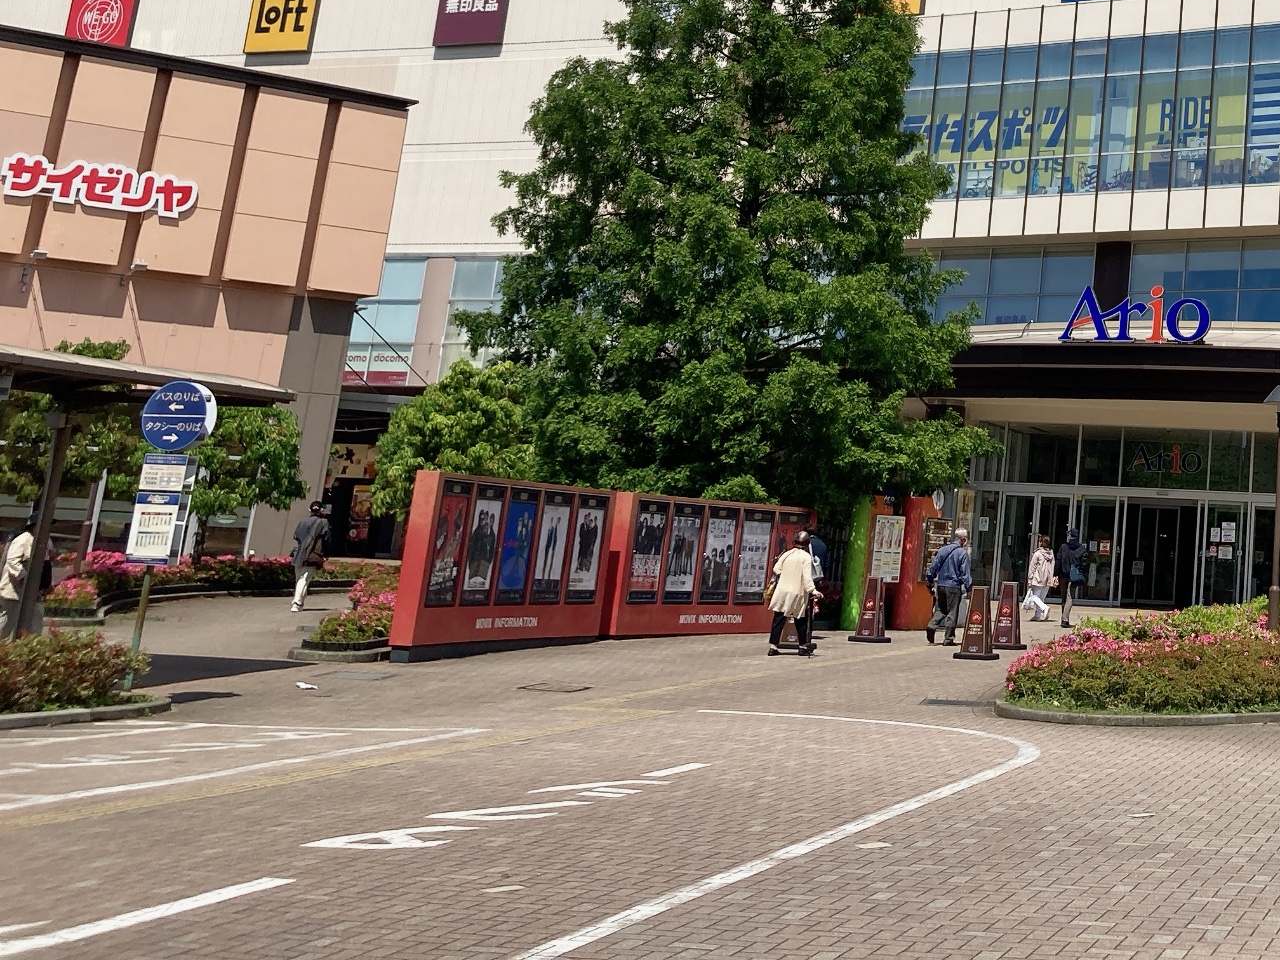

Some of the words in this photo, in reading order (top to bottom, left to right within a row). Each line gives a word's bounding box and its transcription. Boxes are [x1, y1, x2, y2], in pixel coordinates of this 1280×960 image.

[1160, 95, 1210, 132] RIDE
[902, 106, 1070, 155] ラサキスポーツ
[6, 155, 194, 214] サイゼリヤ
[1058, 285, 1211, 343] Ario
[156, 392, 200, 402] バスのりば
[145, 421, 202, 432] タクシーのりば
[1127, 443, 1203, 473] Ario
[494, 617, 538, 628] INFORMATION
[699, 614, 743, 624] INFORMATION
